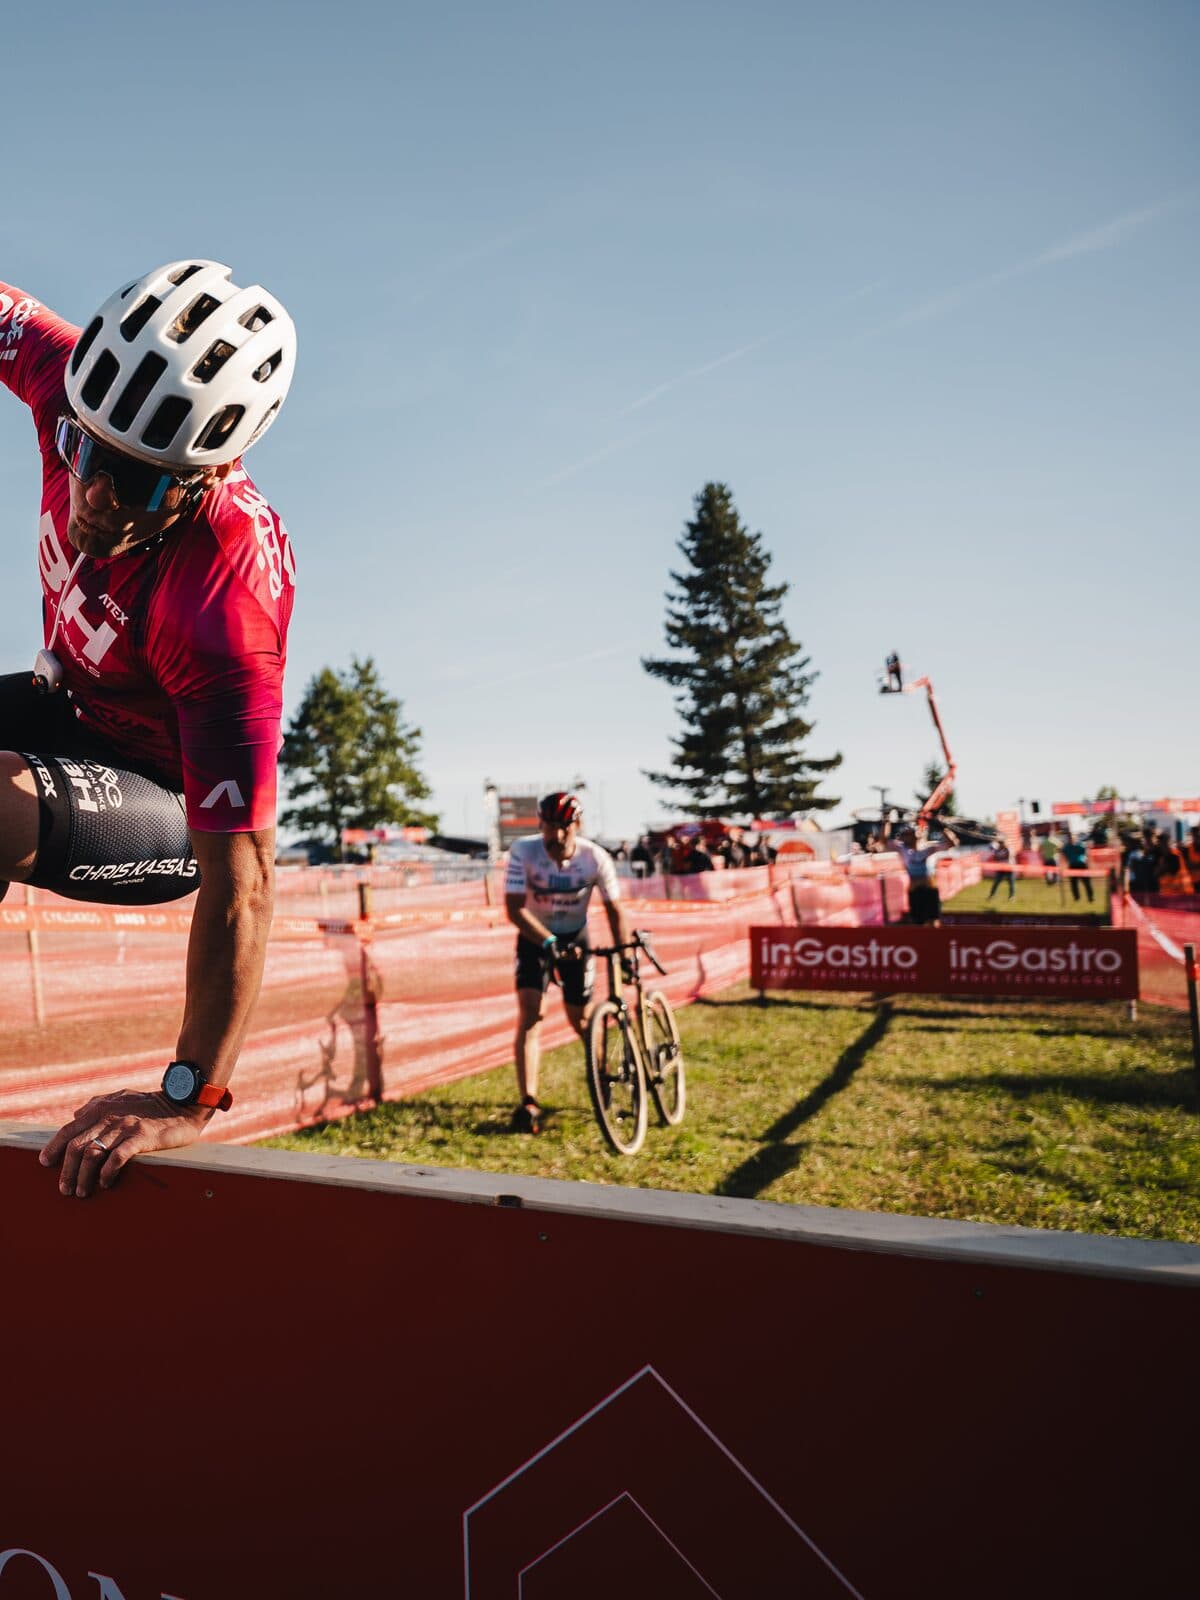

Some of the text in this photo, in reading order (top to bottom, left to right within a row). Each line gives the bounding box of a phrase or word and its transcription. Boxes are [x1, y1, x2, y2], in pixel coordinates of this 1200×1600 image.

[98, 593, 129, 626] ATEX
[54, 757, 99, 813] BH
[94, 786, 107, 812] BIKE
[761, 937, 918, 968] inGastro
[950, 940, 1122, 971] inGastro
